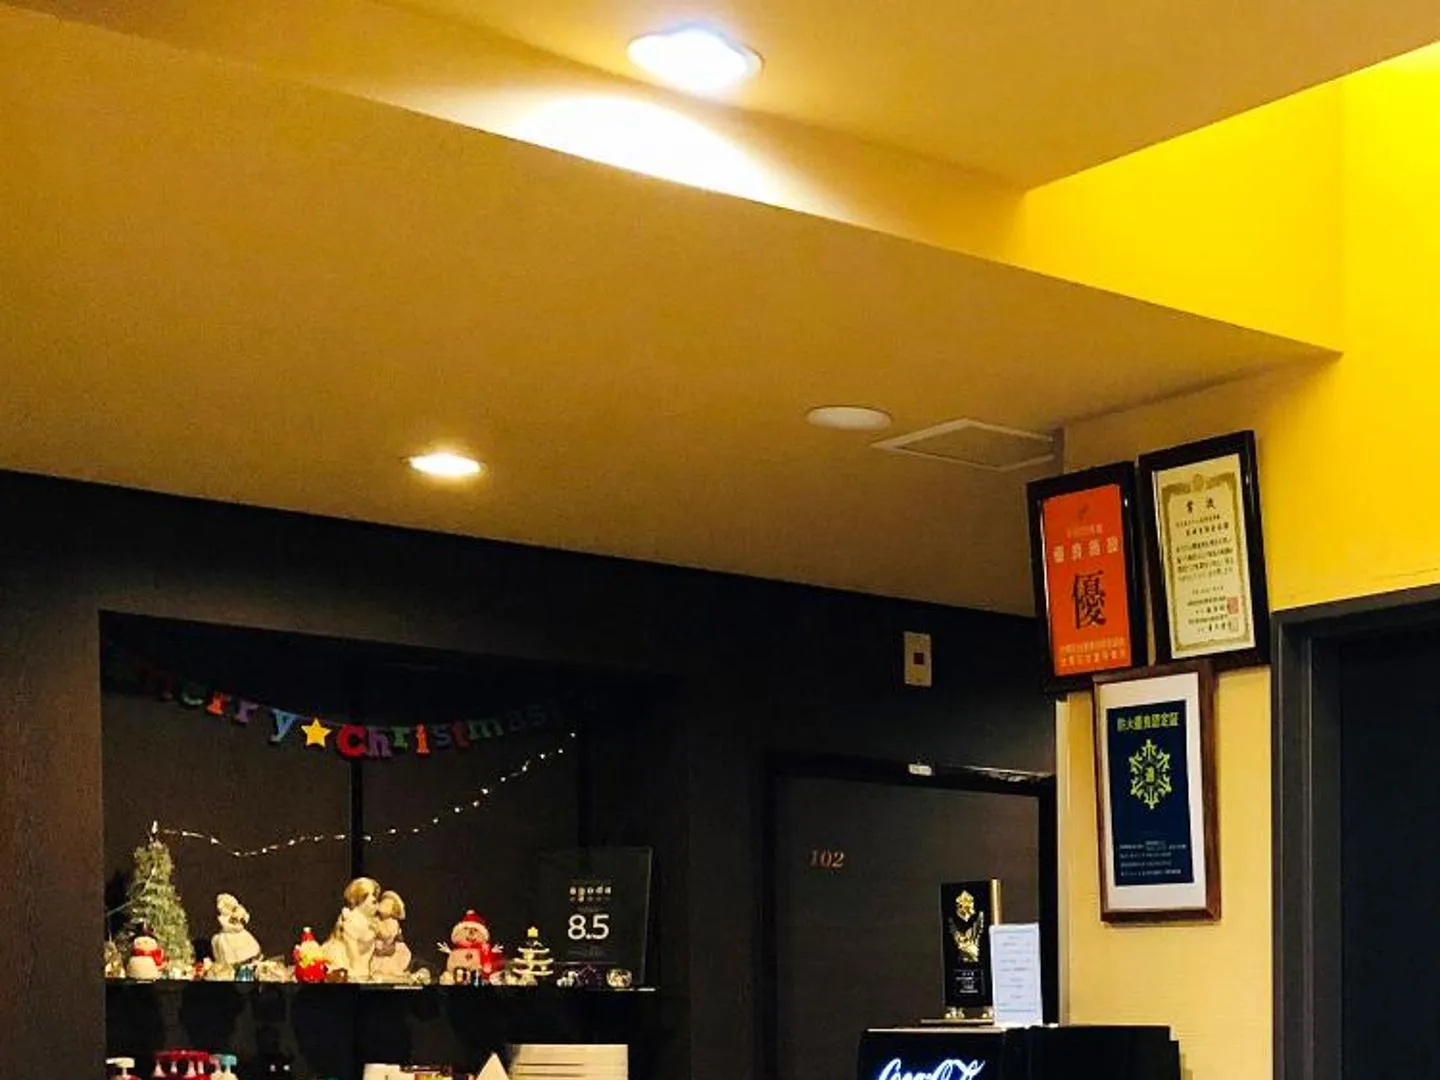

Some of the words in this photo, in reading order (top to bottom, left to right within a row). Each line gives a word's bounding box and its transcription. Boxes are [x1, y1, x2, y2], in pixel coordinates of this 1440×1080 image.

[1072, 570, 1106, 630] 優
[810, 848, 845, 868] 102
[567, 913, 610, 940] 8.5
